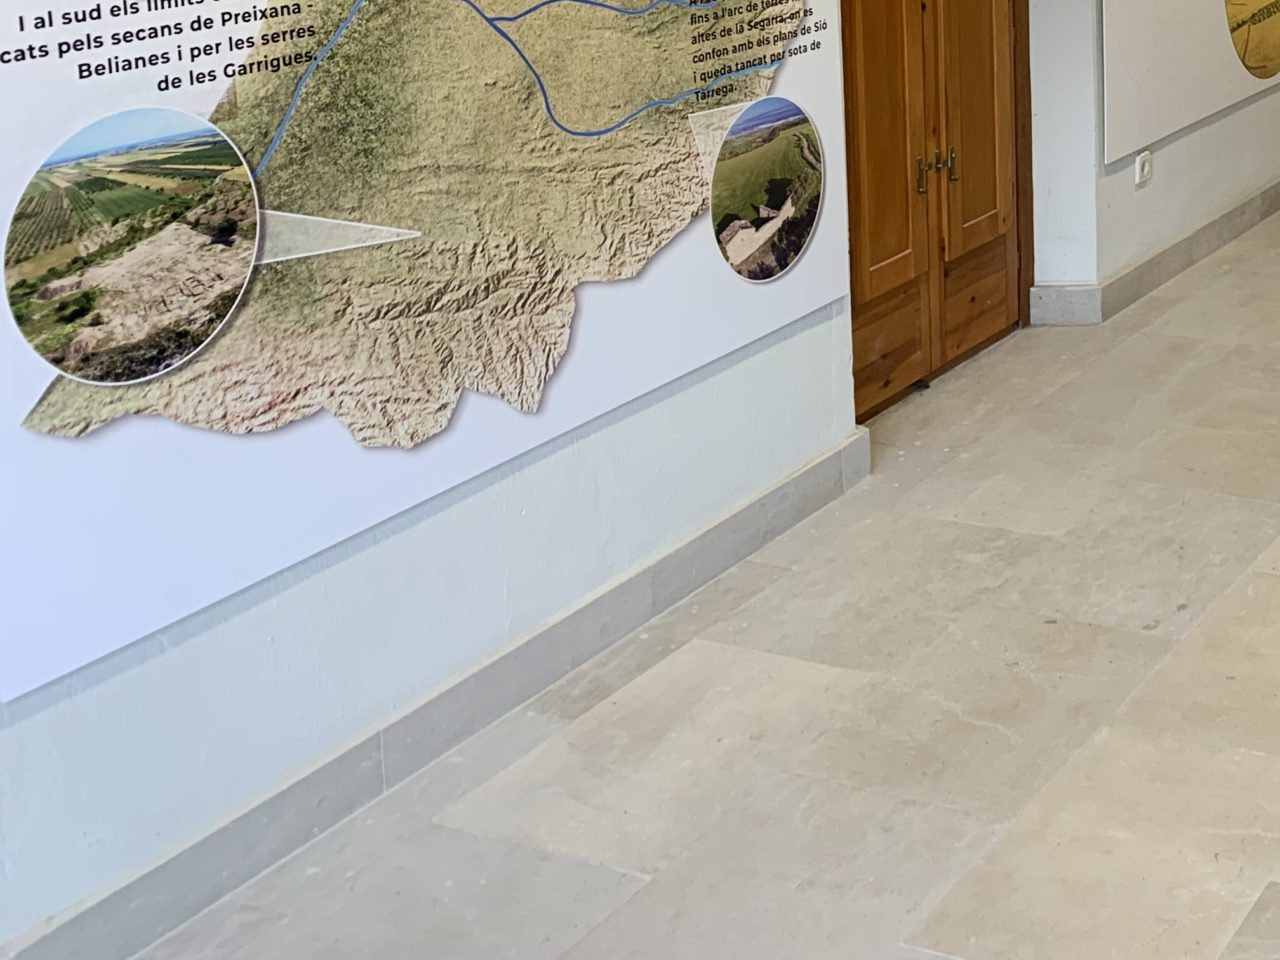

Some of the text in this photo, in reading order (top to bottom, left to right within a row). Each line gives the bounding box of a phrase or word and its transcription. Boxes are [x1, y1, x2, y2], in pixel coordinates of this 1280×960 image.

[0, 2, 302, 64] cats pels secans de Preixana
[18, 15, 25, 32] I
[34, 10, 53, 30] al
[61, 3, 102, 25] sud
[109, 0, 140, 18] els
[690, 12, 710, 26] fins
[713, 10, 718, 20] a
[722, 5, 743, 18] l'arc
[746, 0, 758, 12] de
[692, 7, 814, 44] altes de la Segarra, on es
[77, 24, 317, 80] Belianes per les serres
[692, 20, 828, 64] confon amb els plans de Sió
[700, 40, 821, 84] queda tancat per sota de
[157, 50, 318, 92] de les Garrigues.
[694, 84, 737, 102] Tàrrega.
